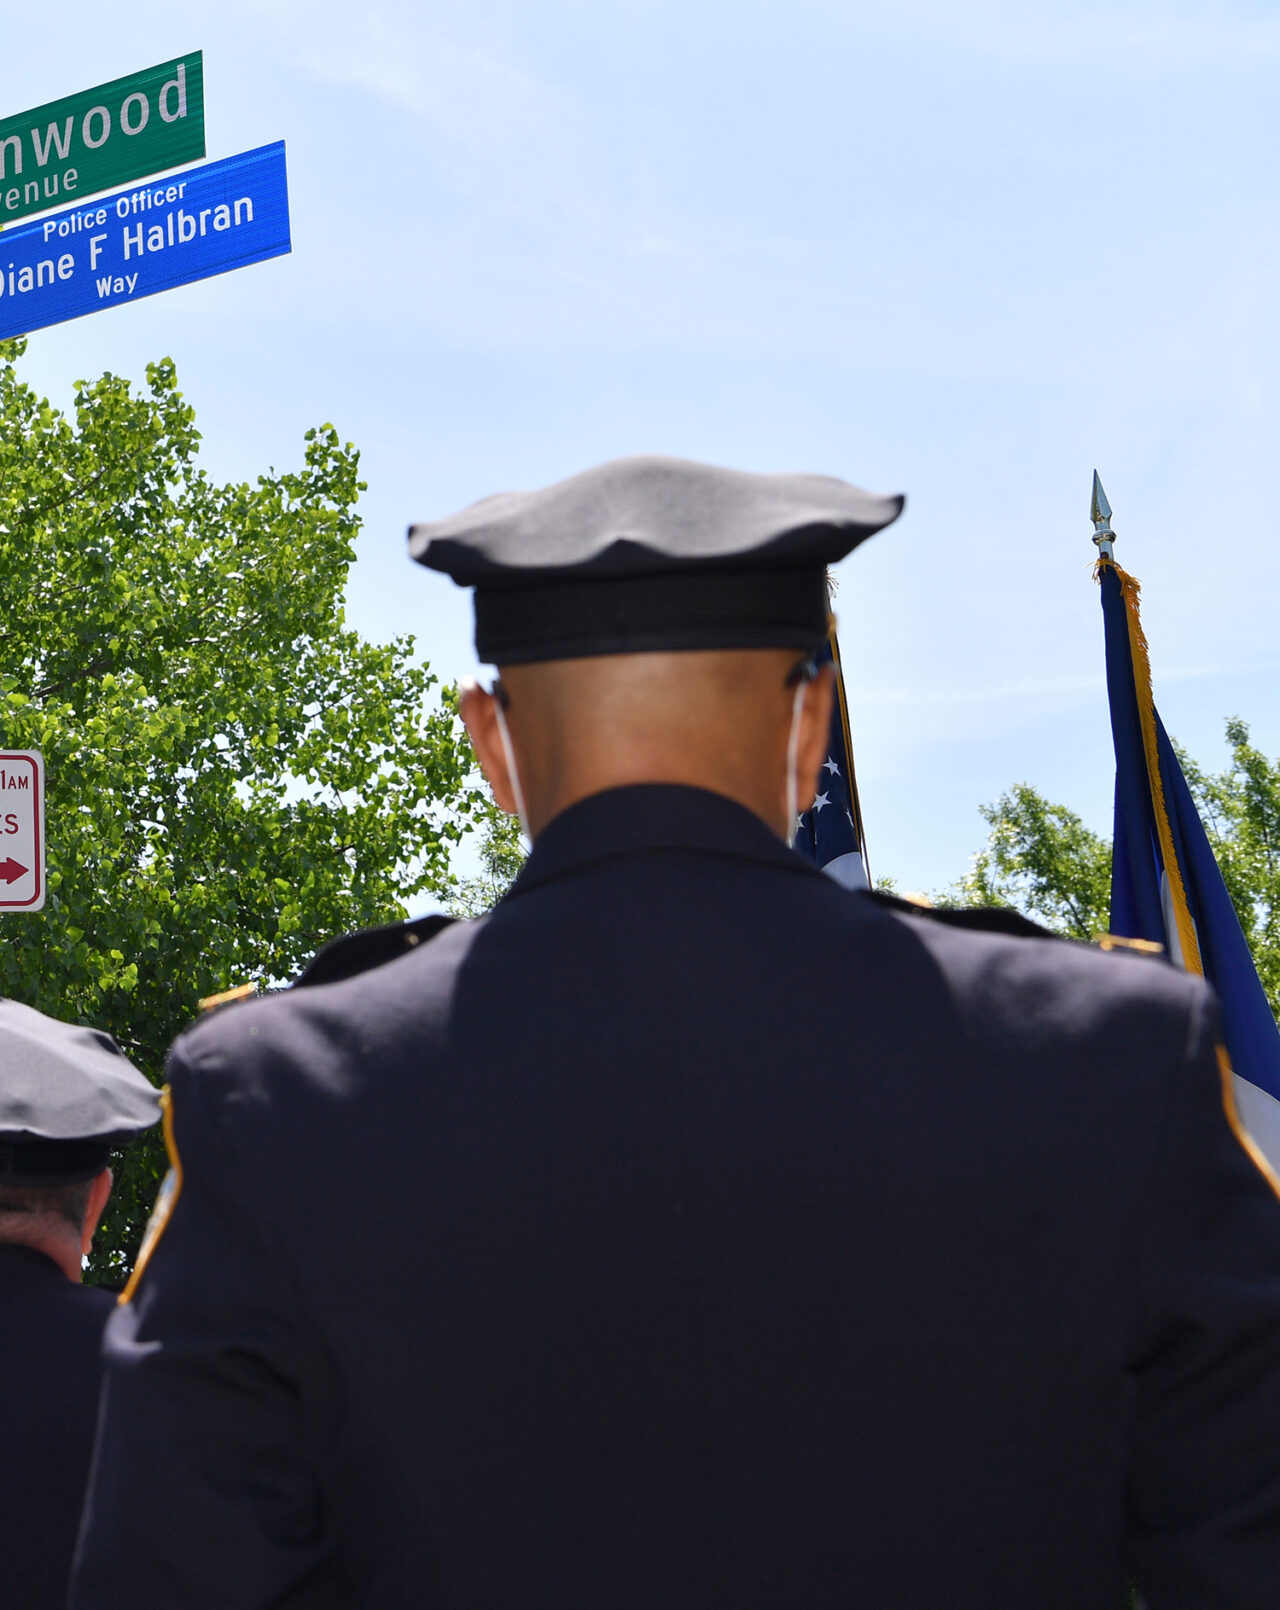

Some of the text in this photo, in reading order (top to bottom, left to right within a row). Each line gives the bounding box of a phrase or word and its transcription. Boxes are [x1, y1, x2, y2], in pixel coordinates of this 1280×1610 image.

[43, 181, 187, 242] Police Officer
[90, 234, 108, 270] F
[123, 197, 254, 260] Halbran
[96, 272, 139, 299] Way
